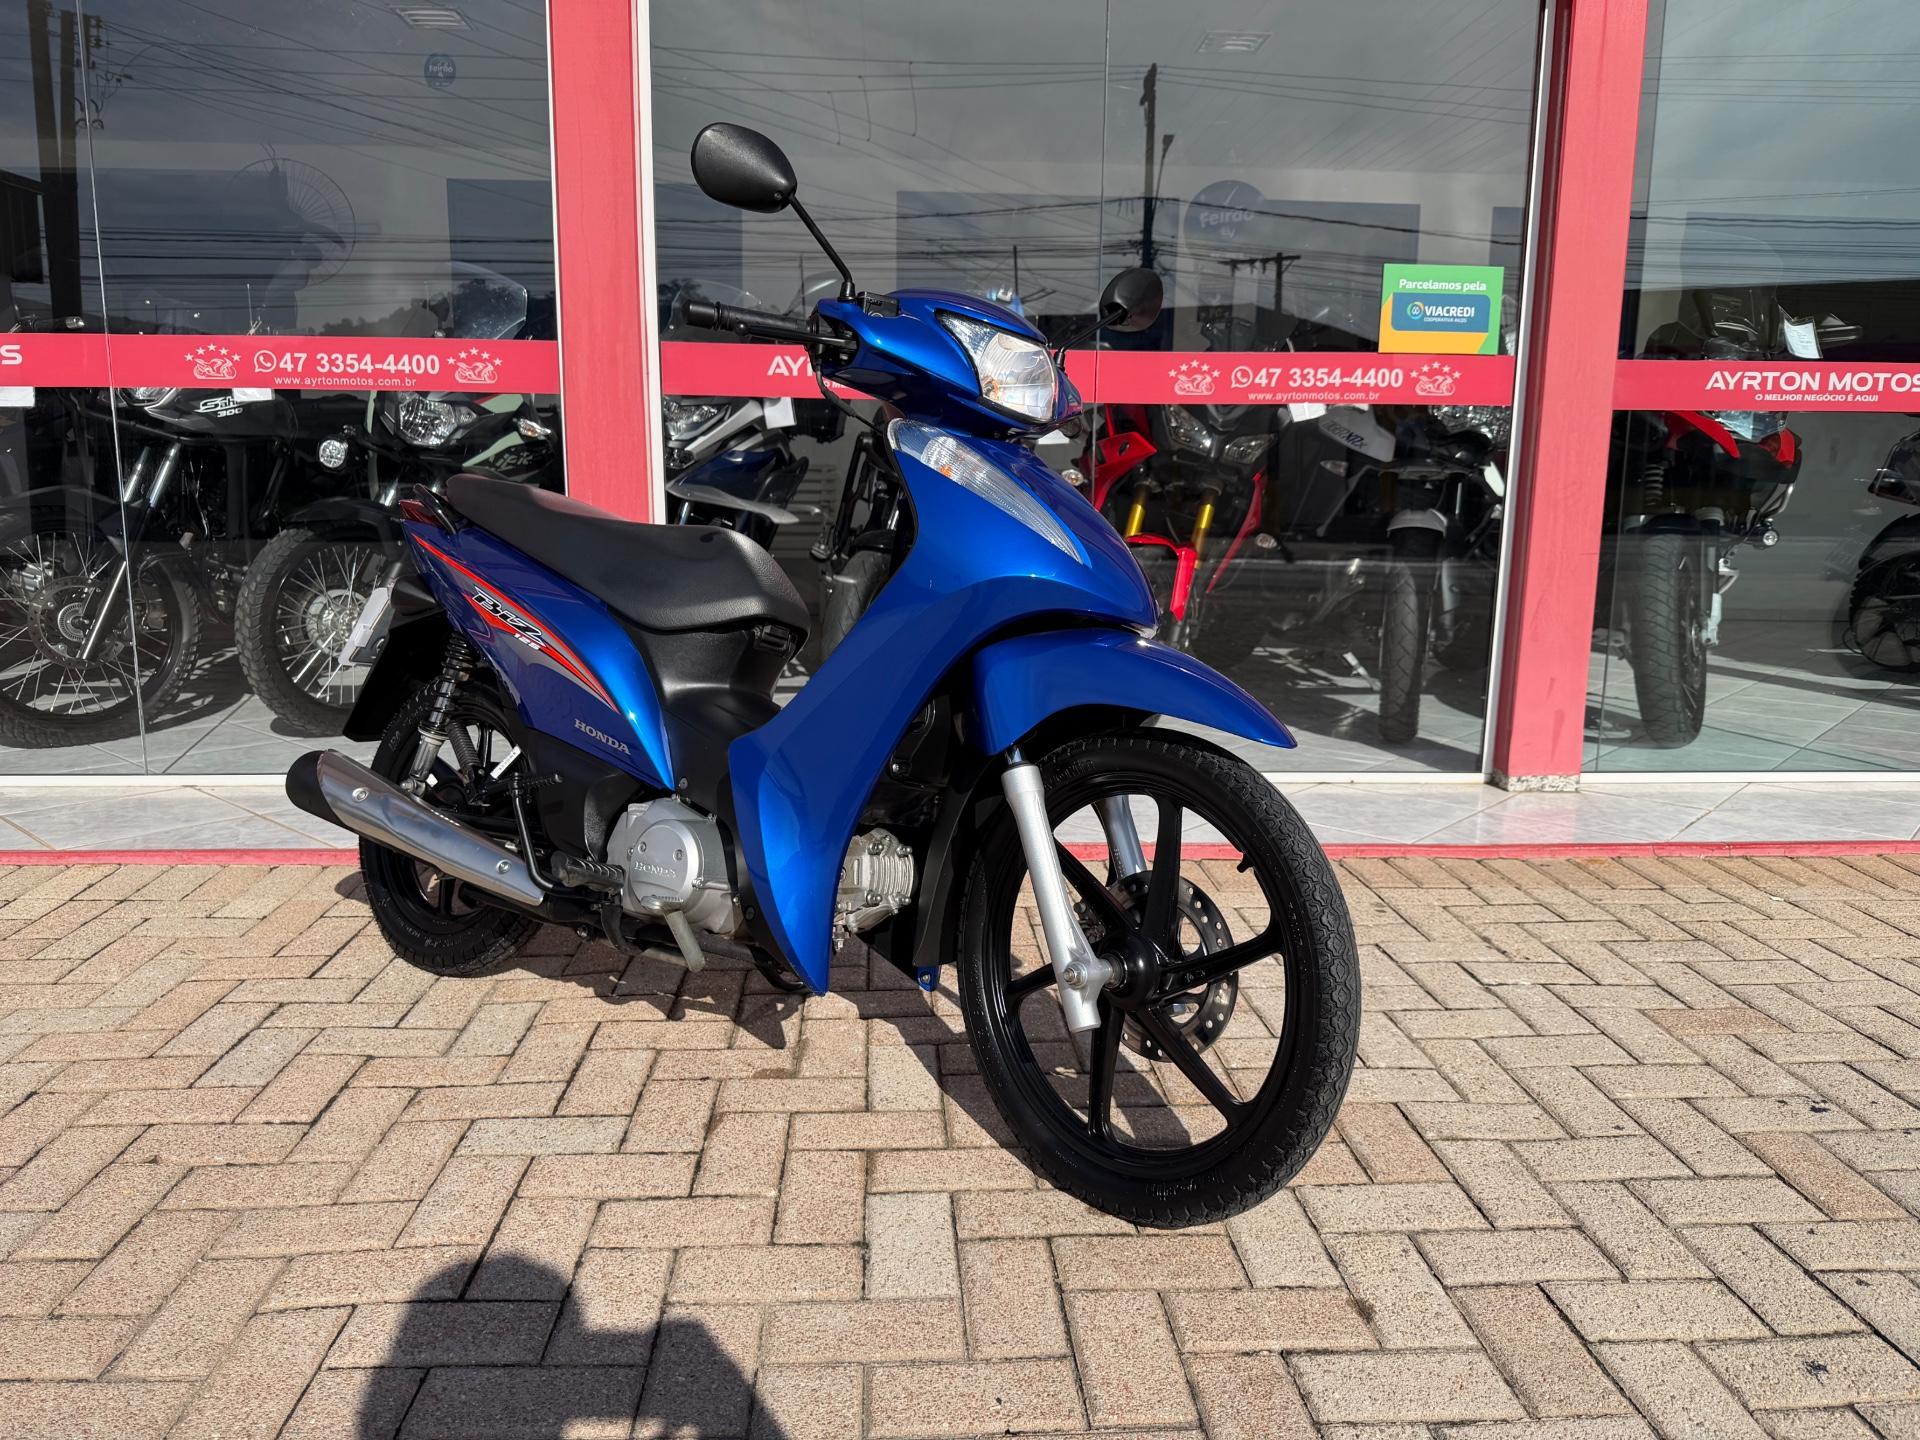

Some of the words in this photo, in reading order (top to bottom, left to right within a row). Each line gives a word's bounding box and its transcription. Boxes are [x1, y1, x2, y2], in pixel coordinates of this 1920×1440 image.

[1399, 278, 1462, 290] Parcelamos
[1463, 280, 1487, 292] pela
[1424, 305, 1475, 318] VIACREDI
[279, 352, 308, 373] 47
[316, 353, 440, 375] 3354-4400
[274, 376, 417, 387] www.ayrtonmotos.com.br
[1254, 368, 1282, 388] 47
[1288, 368, 1404, 388] 3354-4400
[1705, 370, 1820, 391] AYRTON
[1248, 391, 1380, 402] www.ayrtonmotos.com.br
[1755, 393, 1763, 401] O
[1764, 393, 1803, 401] MELHOR
[1804, 392, 1846, 402] NEGÓCIO
[1854, 394, 1879, 402] AQUI
[217, 407, 243, 418] 300
[514, 632, 542, 651] 125
[574, 718, 631, 755] HONDA
